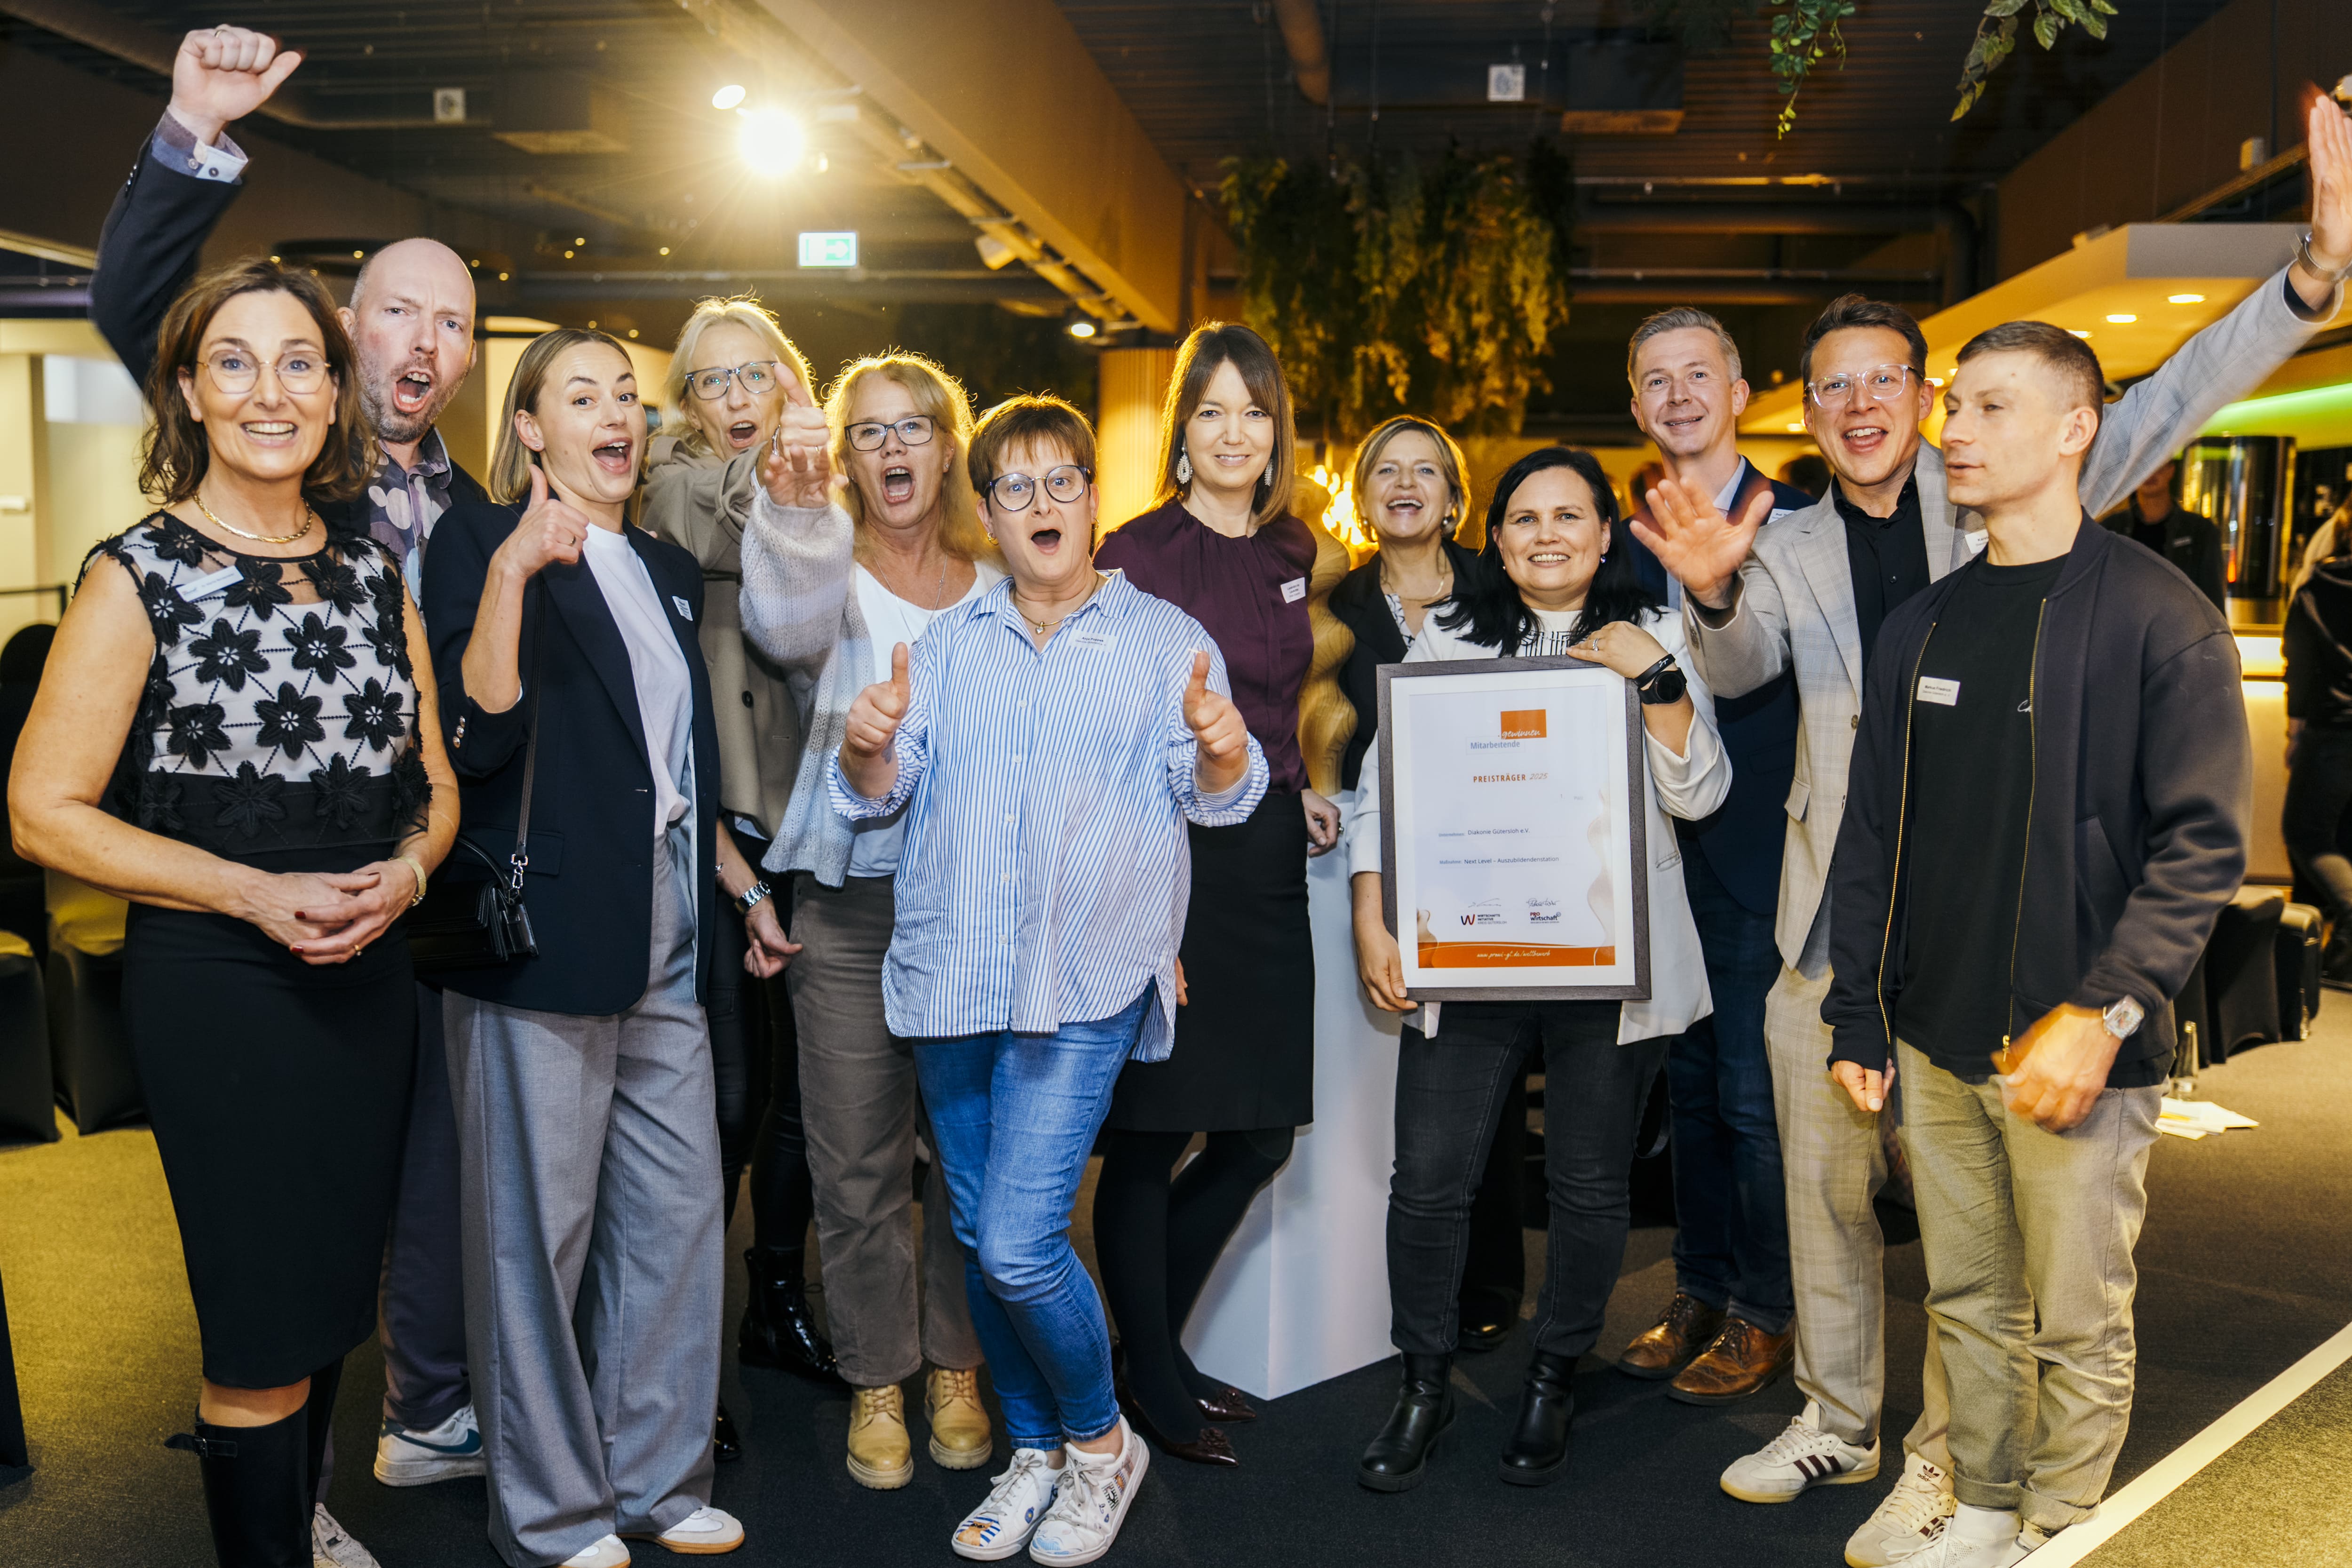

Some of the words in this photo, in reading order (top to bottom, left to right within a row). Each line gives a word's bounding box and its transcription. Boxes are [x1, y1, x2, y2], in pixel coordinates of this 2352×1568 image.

[1501, 728, 1541, 740] gewinnen
[1470, 740, 1520, 749] Mitarbeitende
[1473, 772, 1526, 783] PREISTRÄGER
